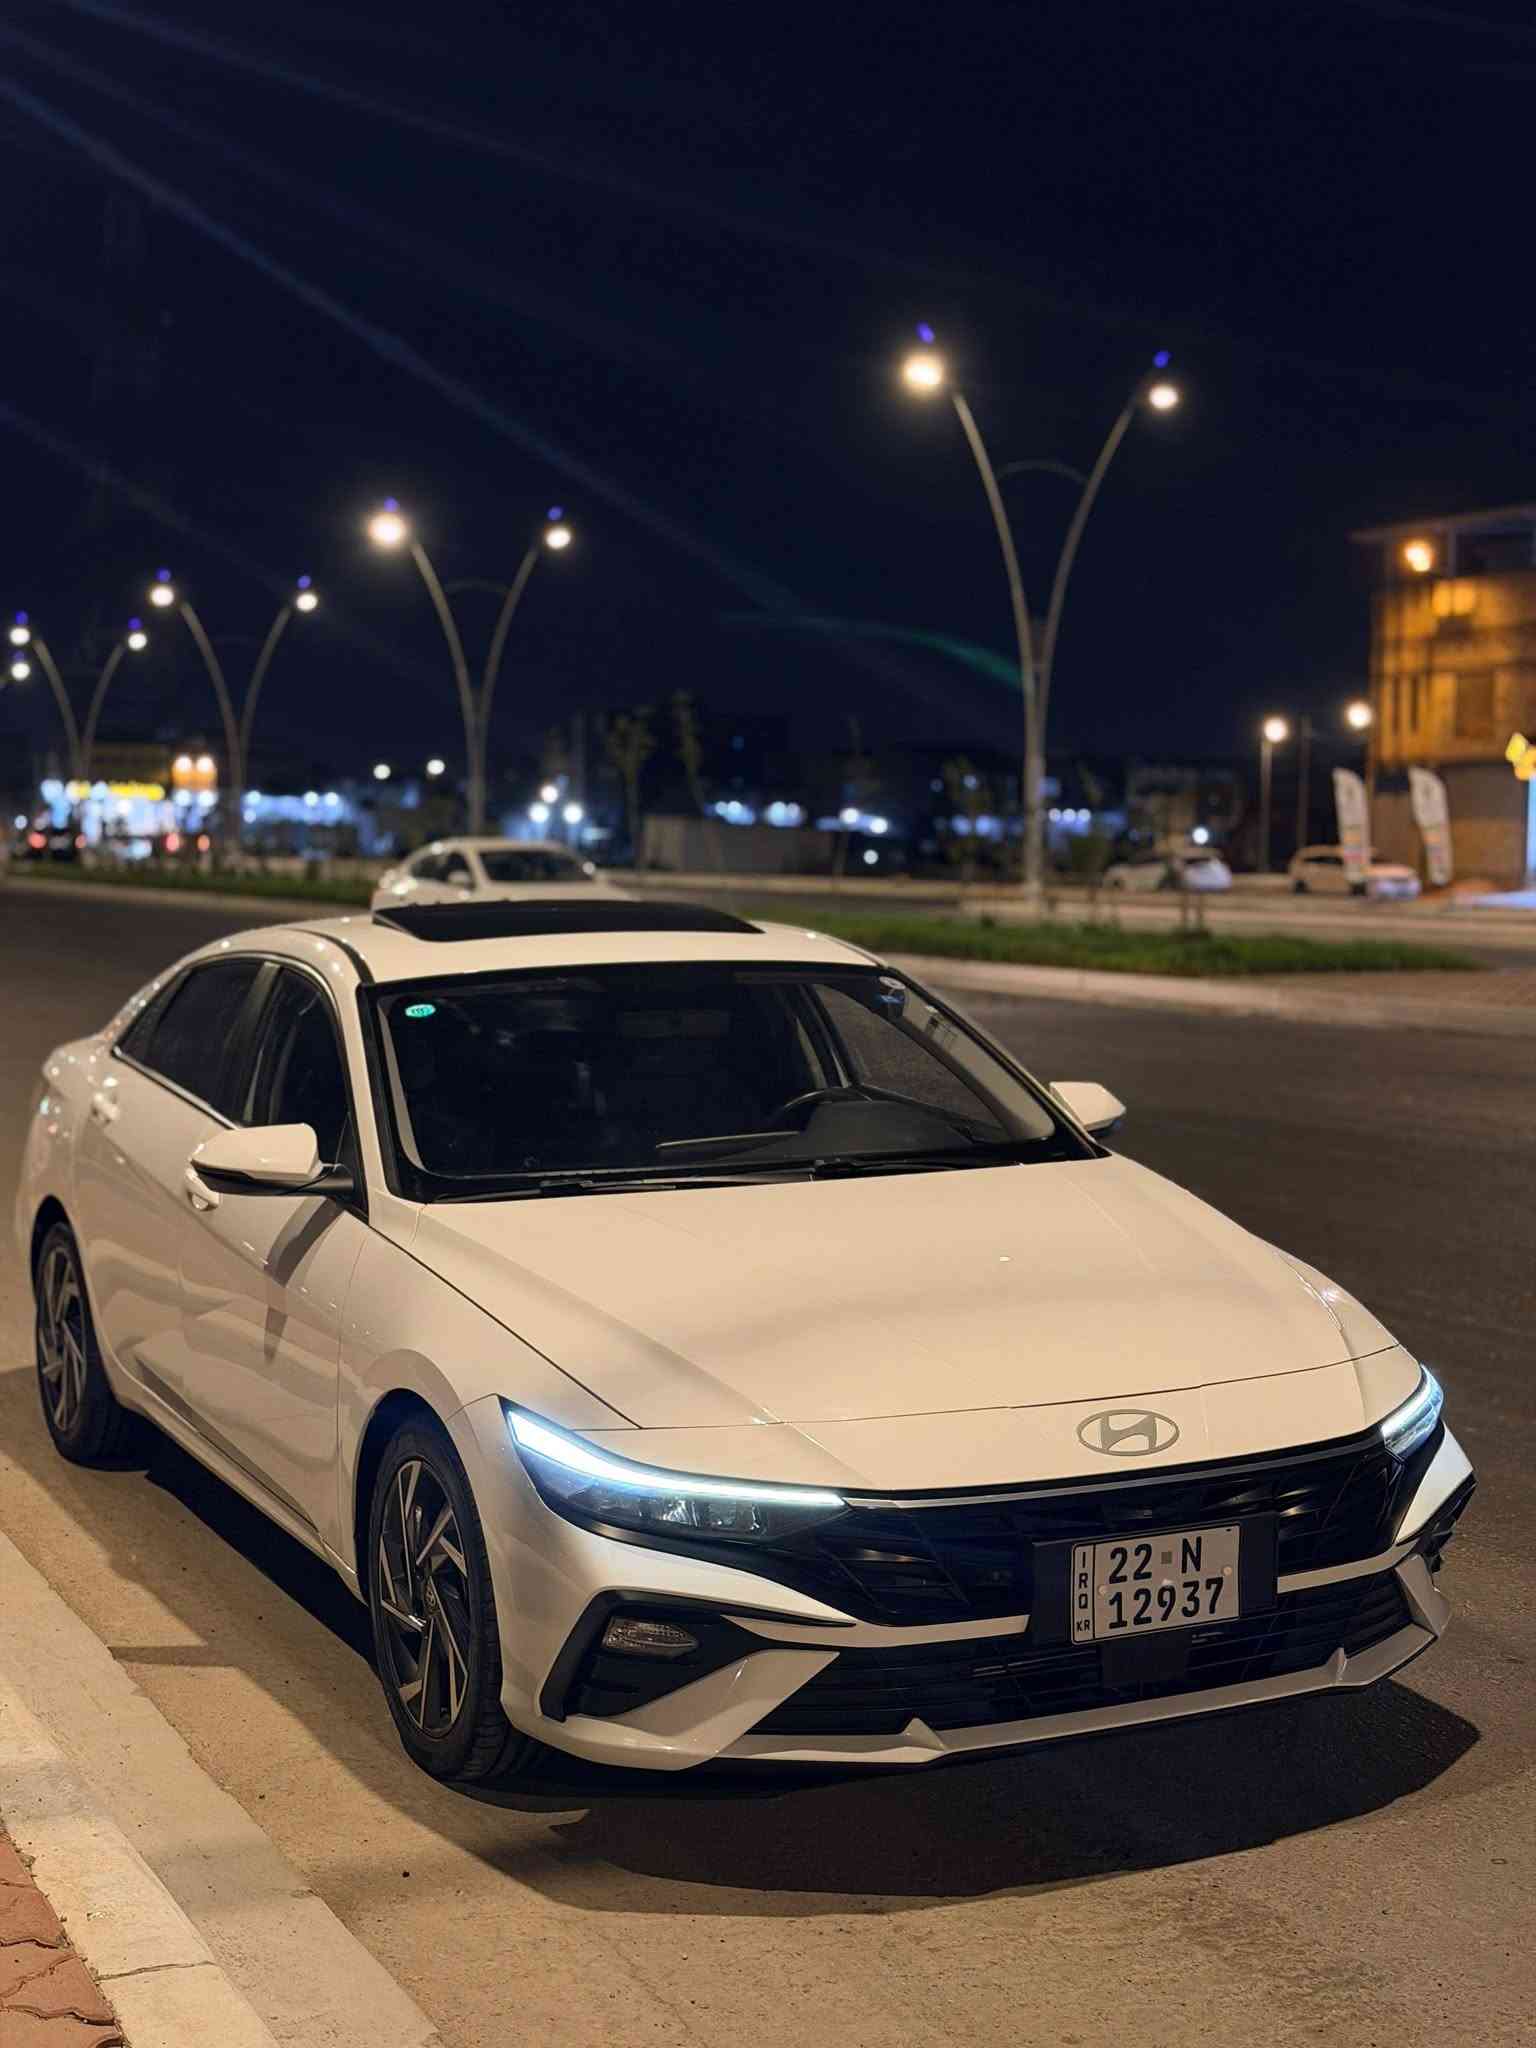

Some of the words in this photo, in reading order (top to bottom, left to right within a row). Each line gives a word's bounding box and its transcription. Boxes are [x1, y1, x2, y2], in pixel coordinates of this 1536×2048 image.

[1109, 1543, 1153, 1584] 22
[1181, 1536, 1202, 1574] N
[1076, 1619, 1090, 1632] KR
[1109, 1577, 1224, 1629] 12937
